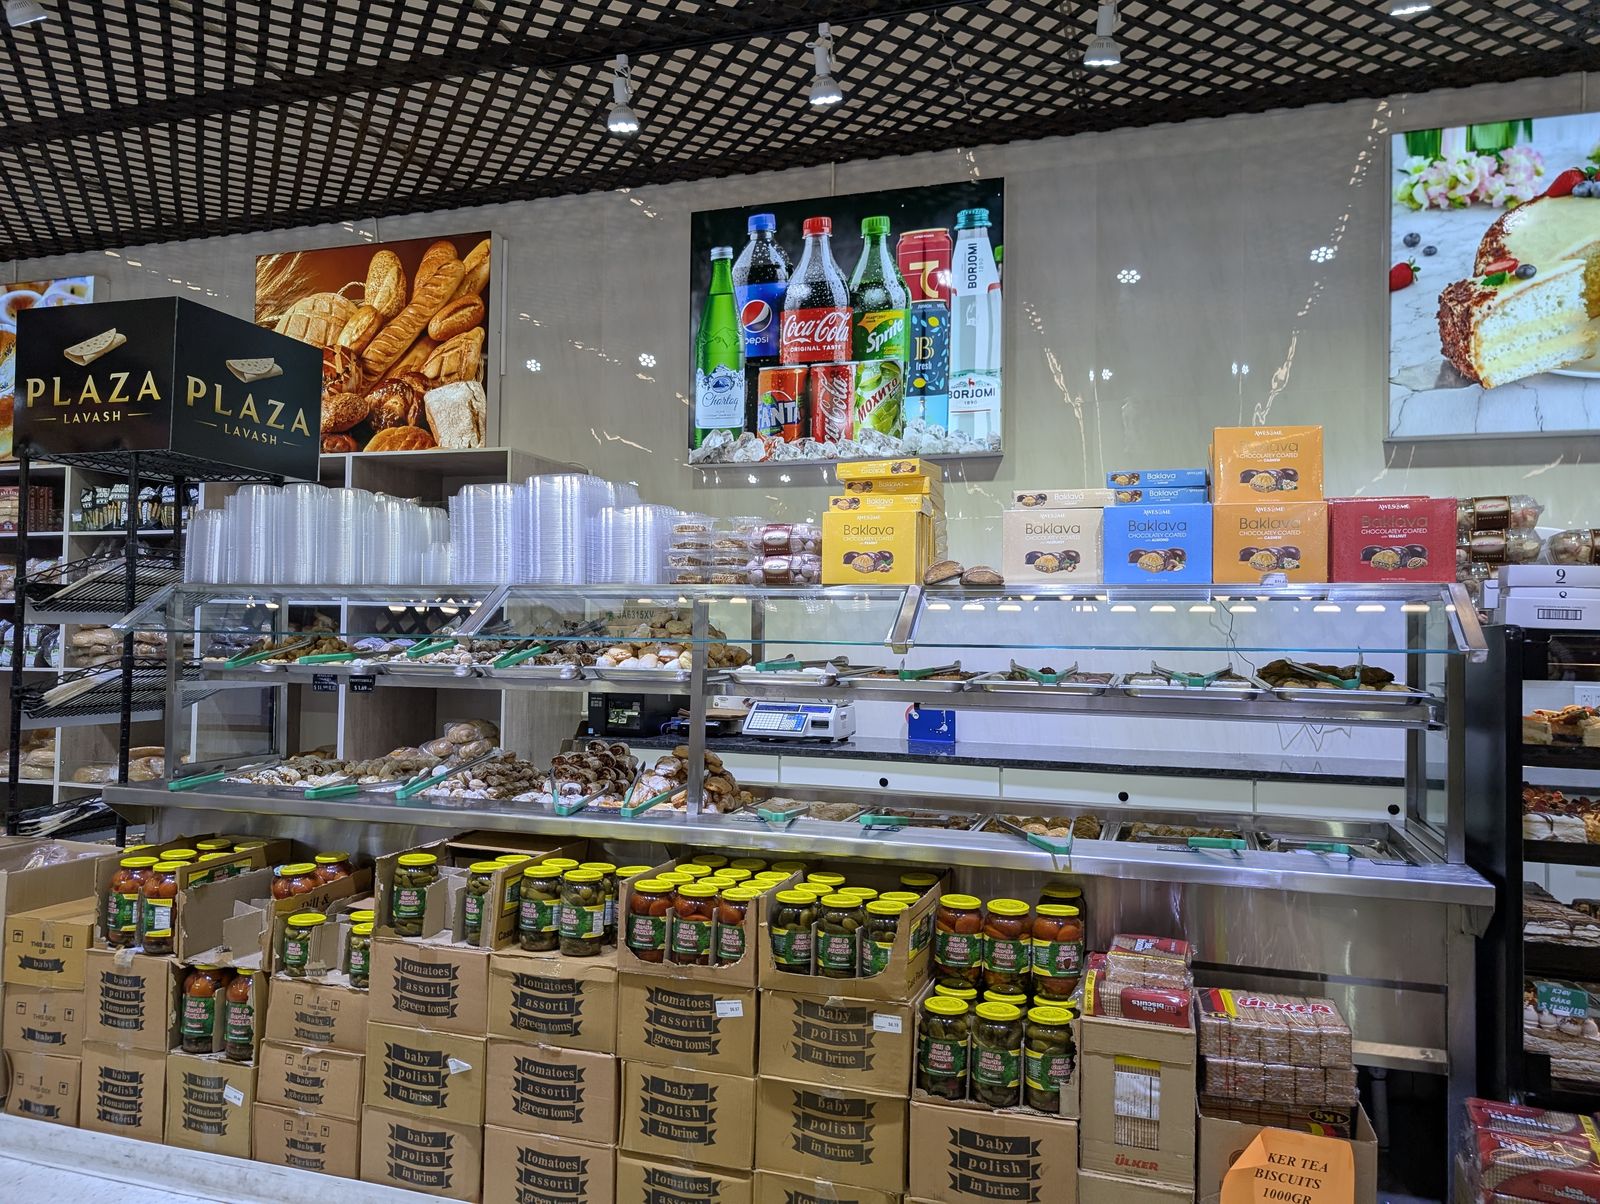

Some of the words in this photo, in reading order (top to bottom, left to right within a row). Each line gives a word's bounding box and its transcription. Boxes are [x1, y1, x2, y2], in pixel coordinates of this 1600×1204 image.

[968, 242, 977, 289] BORJOMI
[783, 312, 850, 345] Coca-Cola
[866, 318, 904, 354] Sprite
[745, 335, 769, 346] pepsi
[790, 345, 821, 353] ORIGINAL
[915, 362, 933, 371] fresh
[26, 370, 161, 407] PLAZA
[948, 387, 996, 399] BORJOMI
[186, 375, 311, 437] PLAZA
[819, 371, 849, 445] ca-Cola
[858, 378, 898, 424] МОХИТО
[64, 410, 121, 424] LAVASH
[224, 423, 278, 446] LAVASH
[1239, 440, 1298, 451] Blava
[843, 524, 894, 535] Baklava
[1025, 523, 1080, 534] Baklava
[1128, 520, 1187, 531] Baklava
[1239, 517, 1301, 530] Baklava
[1361, 516, 1429, 528] Baklava
[33, 959, 54, 970] baby
[403, 960, 450, 976] tomatoes
[113, 975, 133, 988] baby
[406, 981, 445, 995] assorti
[523, 977, 574, 992] tomatoes
[109, 988, 136, 999] polish
[657, 993, 711, 1009] tomatoes
[105, 1002, 139, 1014] tomatoes
[400, 1000, 426, 1013] green
[427, 1003, 449, 1014] toms
[525, 999, 568, 1012] assorti
[1131, 999, 1165, 1010] biscuits
[660, 1014, 706, 1029] assorti
[818, 1006, 850, 1023] baby
[107, 1017, 135, 1028] assorti
[519, 1017, 546, 1032] green
[548, 1023, 572, 1032] toms
[35, 1029, 54, 1041] baby
[653, 1033, 683, 1048] green
[685, 1039, 711, 1050] toms
[810, 1027, 857, 1043] polish
[404, 1049, 431, 1065] baby
[811, 1048, 822, 1059] in
[825, 1051, 856, 1065] brine
[112, 1070, 131, 1082] baby
[398, 1068, 435, 1083] polish
[524, 1061, 575, 1078] tomatoes
[196, 1076, 215, 1088] baby
[296, 1075, 313, 1087] baby
[107, 1085, 134, 1096] polish
[192, 1091, 219, 1103] polish
[399, 1087, 407, 1098] in
[408, 1089, 433, 1103] brine
[527, 1083, 570, 1098] assorti
[664, 1082, 695, 1099] baby
[104, 1098, 136, 1110] tomatoes
[189, 1105, 221, 1117] tomatoes
[521, 1101, 549, 1116] green
[551, 1106, 575, 1118] toms
[657, 1103, 700, 1118] polish
[817, 1097, 850, 1113] baby
[105, 1112, 133, 1124] assorti
[191, 1120, 219, 1132] assorti
[658, 1122, 668, 1135] in
[671, 1125, 699, 1140] brine
[810, 1118, 857, 1135] polish
[407, 1130, 434, 1145] baby
[976, 1135, 1013, 1153] baby
[811, 1139, 822, 1151] in
[824, 1142, 855, 1158] brine
[401, 1150, 439, 1164] polish
[527, 1153, 578, 1170] tomatoes
[1114, 1154, 1158, 1171] ÜLKER
[1267, 1152, 1296, 1167] KER
[1301, 1158, 1329, 1173] TEA
[968, 1158, 1021, 1174] polish
[402, 1168, 410, 1178] in
[412, 1170, 438, 1183] brine
[530, 1174, 573, 1190] assorti
[655, 1173, 709, 1192] tomatoes
[1254, 1168, 1322, 1190] BISCUITS
[970, 1178, 982, 1191] in
[985, 1181, 1020, 1197] brine
[1262, 1187, 1312, 1204] 1000GR
